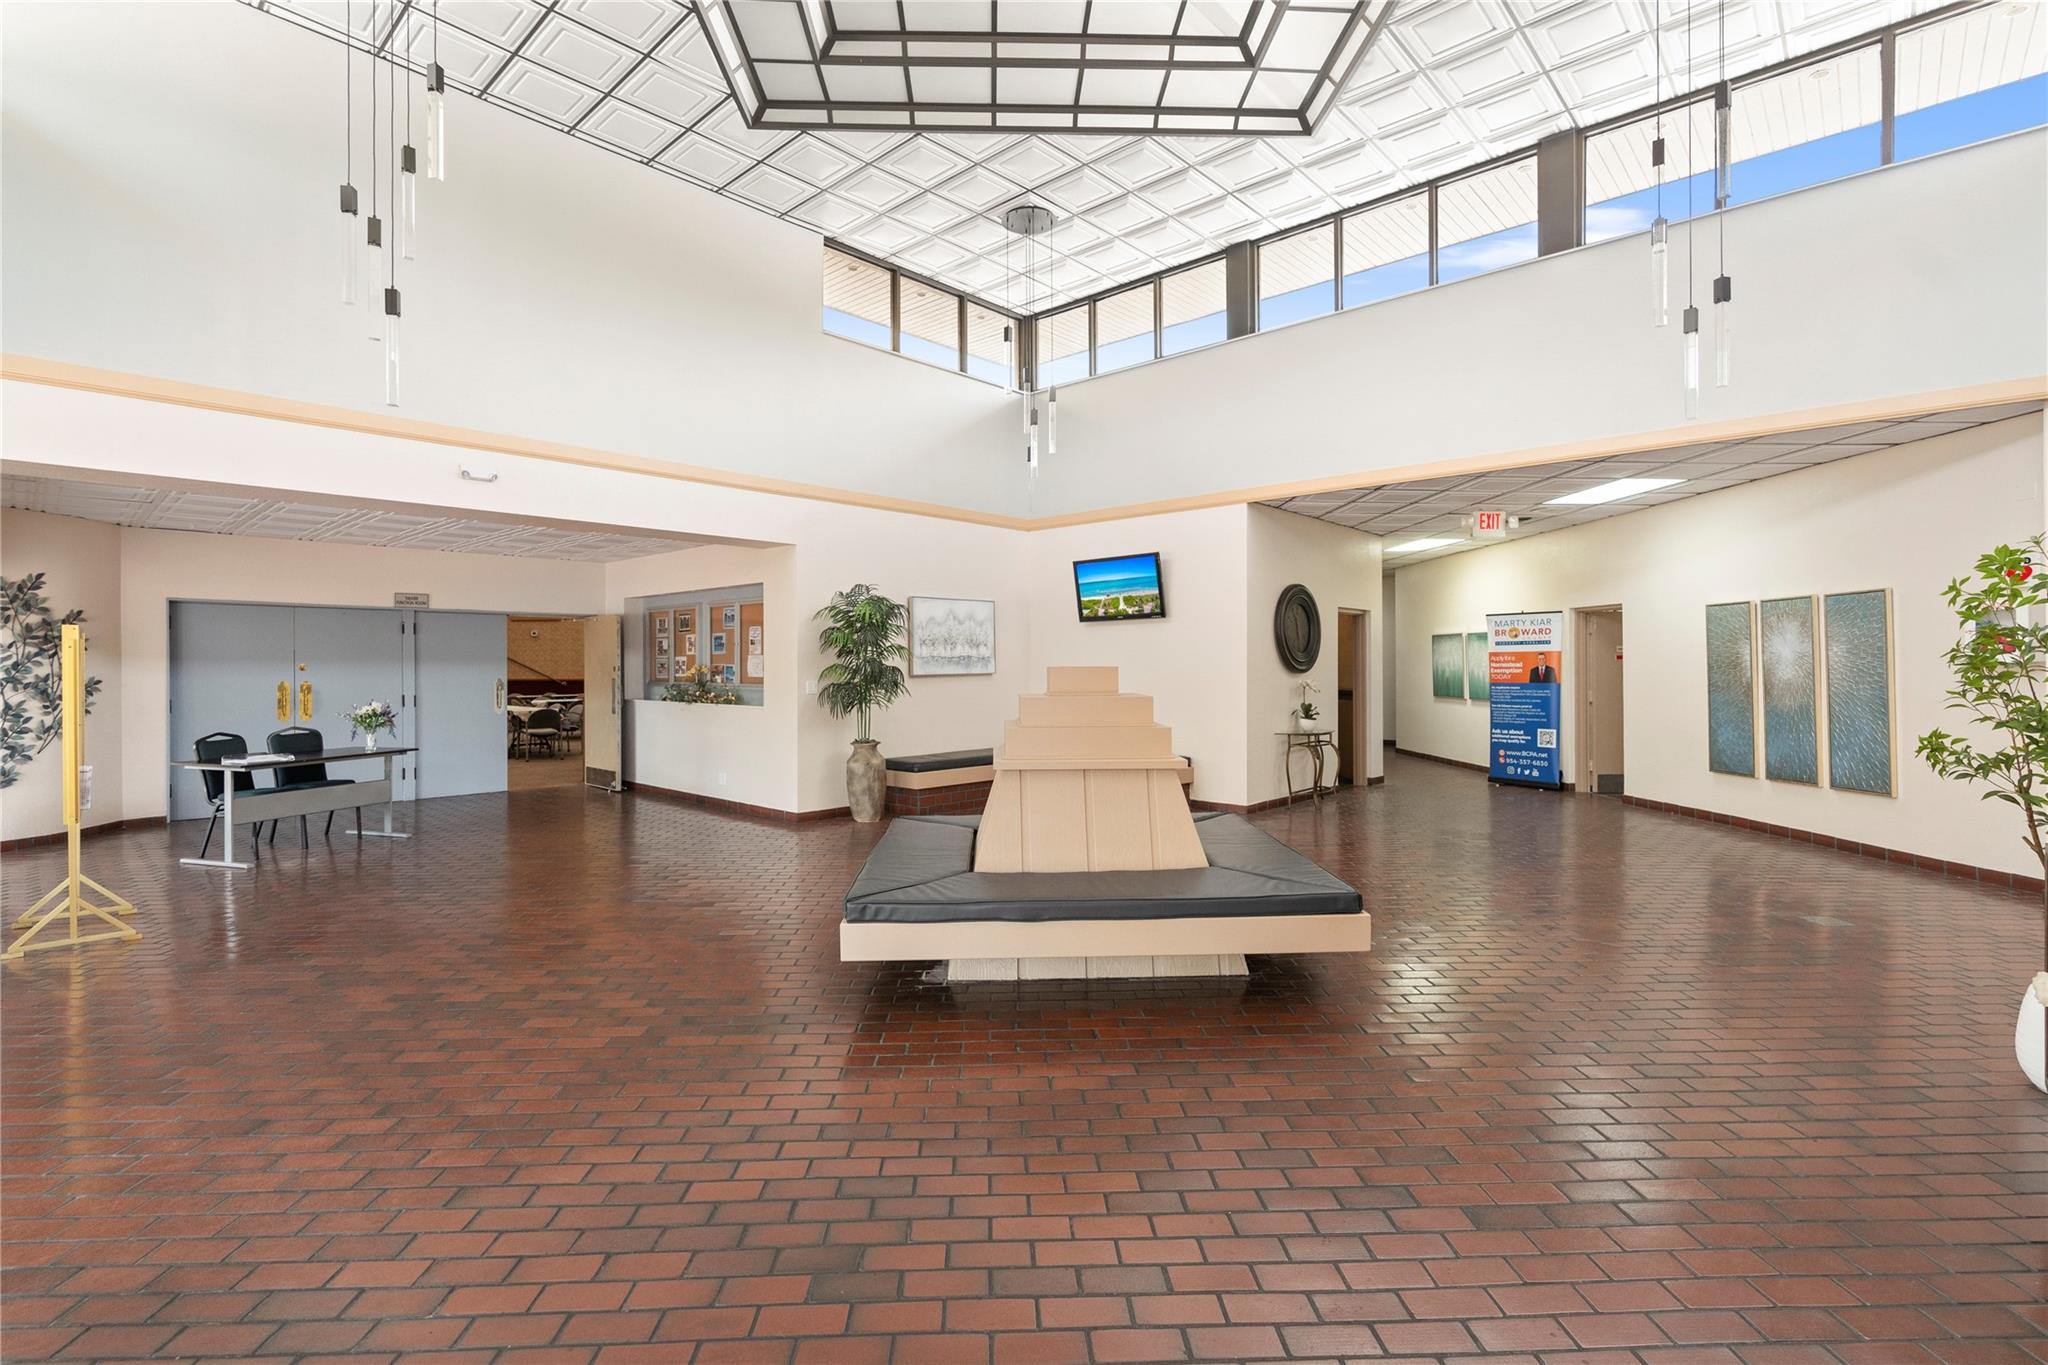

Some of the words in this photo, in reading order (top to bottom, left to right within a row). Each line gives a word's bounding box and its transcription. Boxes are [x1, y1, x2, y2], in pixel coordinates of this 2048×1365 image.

[1479, 512, 1501, 530] EXIT
[1494, 619, 1526, 627] MARTY
[1530, 618, 1552, 626] KIAR
[1494, 627, 1552, 639] BROWARD
[1506, 751, 1548, 759] www.BCPA.net
